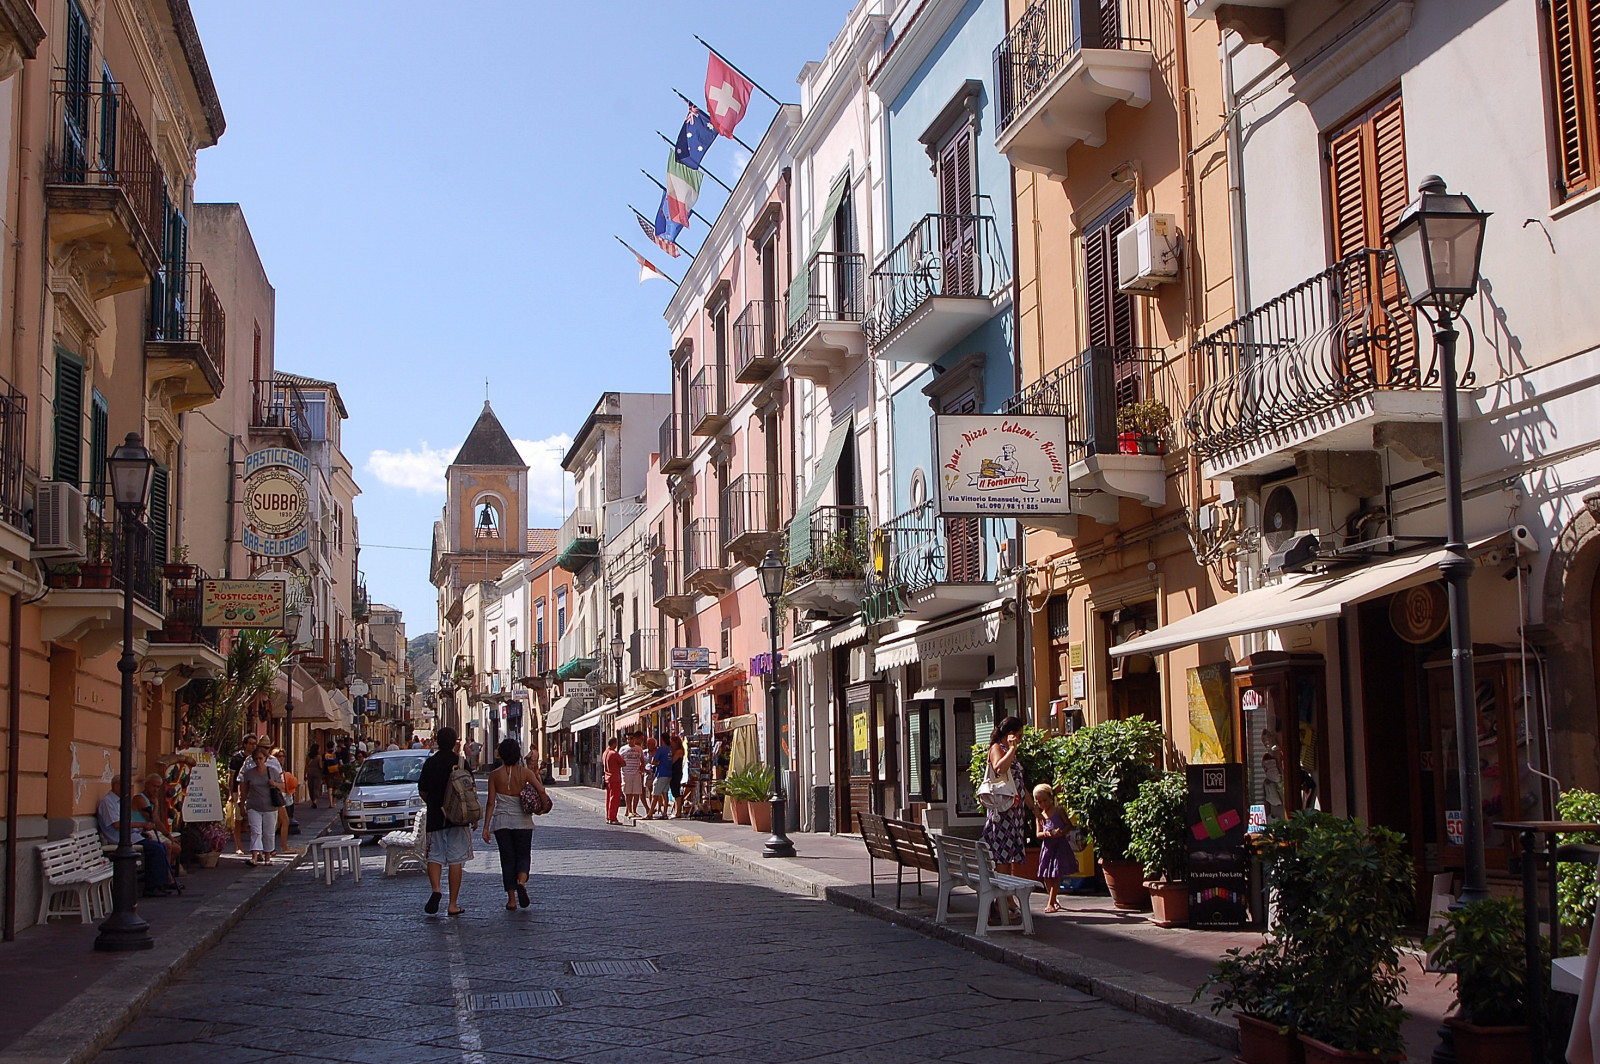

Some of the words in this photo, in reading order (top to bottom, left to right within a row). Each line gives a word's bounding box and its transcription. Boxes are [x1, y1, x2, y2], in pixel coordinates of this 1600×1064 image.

[944, 448, 963, 473] Pane
[961, 426, 988, 447] Pizza
[1001, 420, 1038, 440] Calzoni
[1040, 441, 1065, 475] Biscotti
[245, 448, 309, 475] PASTICCERIA
[987, 477, 1027, 489] Fornaretto
[253, 493, 298, 511] SUBBA
[243, 529, 307, 556] BAR-GELATERIA
[213, 593, 274, 601] ROSTICCERIA
[860, 583, 905, 627] ROLEX
[1248, 813, 1266, 826] 50%
[1199, 871, 1218, 879] always
